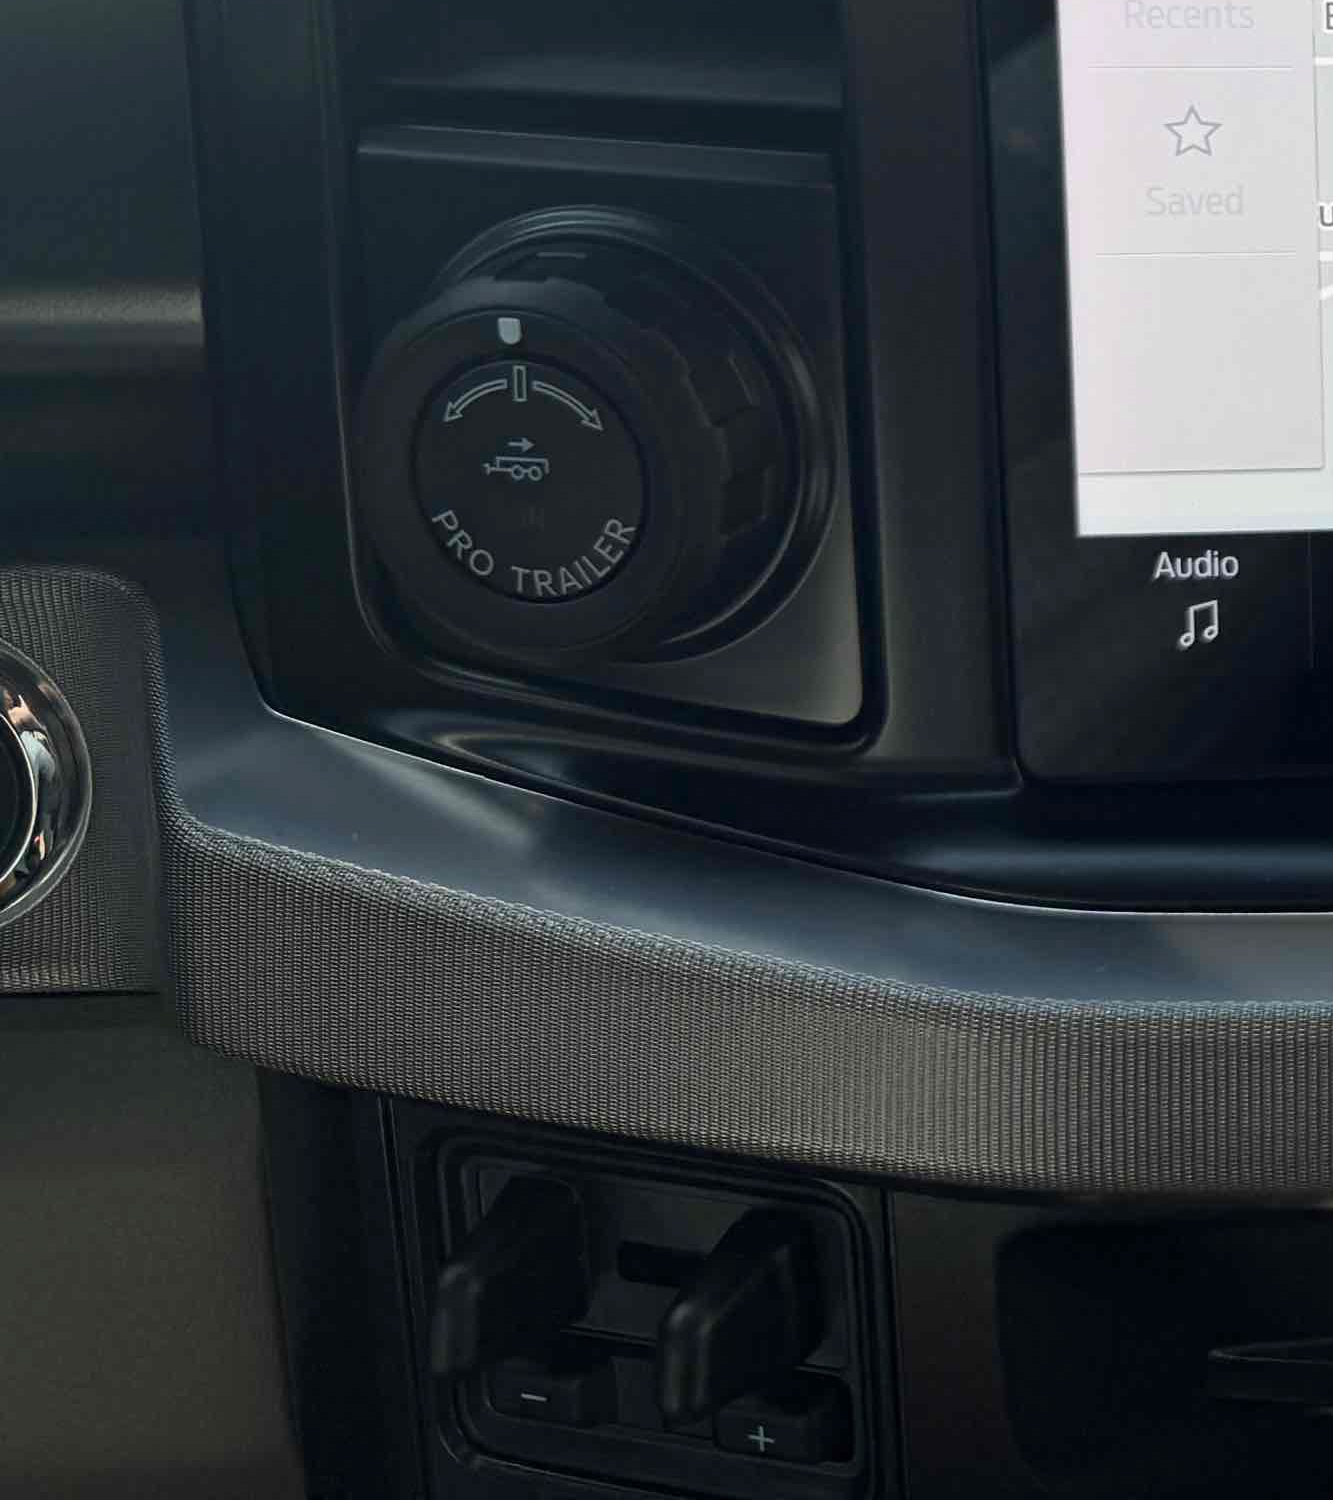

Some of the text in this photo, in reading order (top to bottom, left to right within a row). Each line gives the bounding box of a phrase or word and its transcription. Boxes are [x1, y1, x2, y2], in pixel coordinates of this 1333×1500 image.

[1123, 0, 1255, 30] Recents
[1145, 186, 1243, 217] Saved
[432, 509, 638, 597] PRO TRAILER
[1153, 549, 1239, 581] Audio
